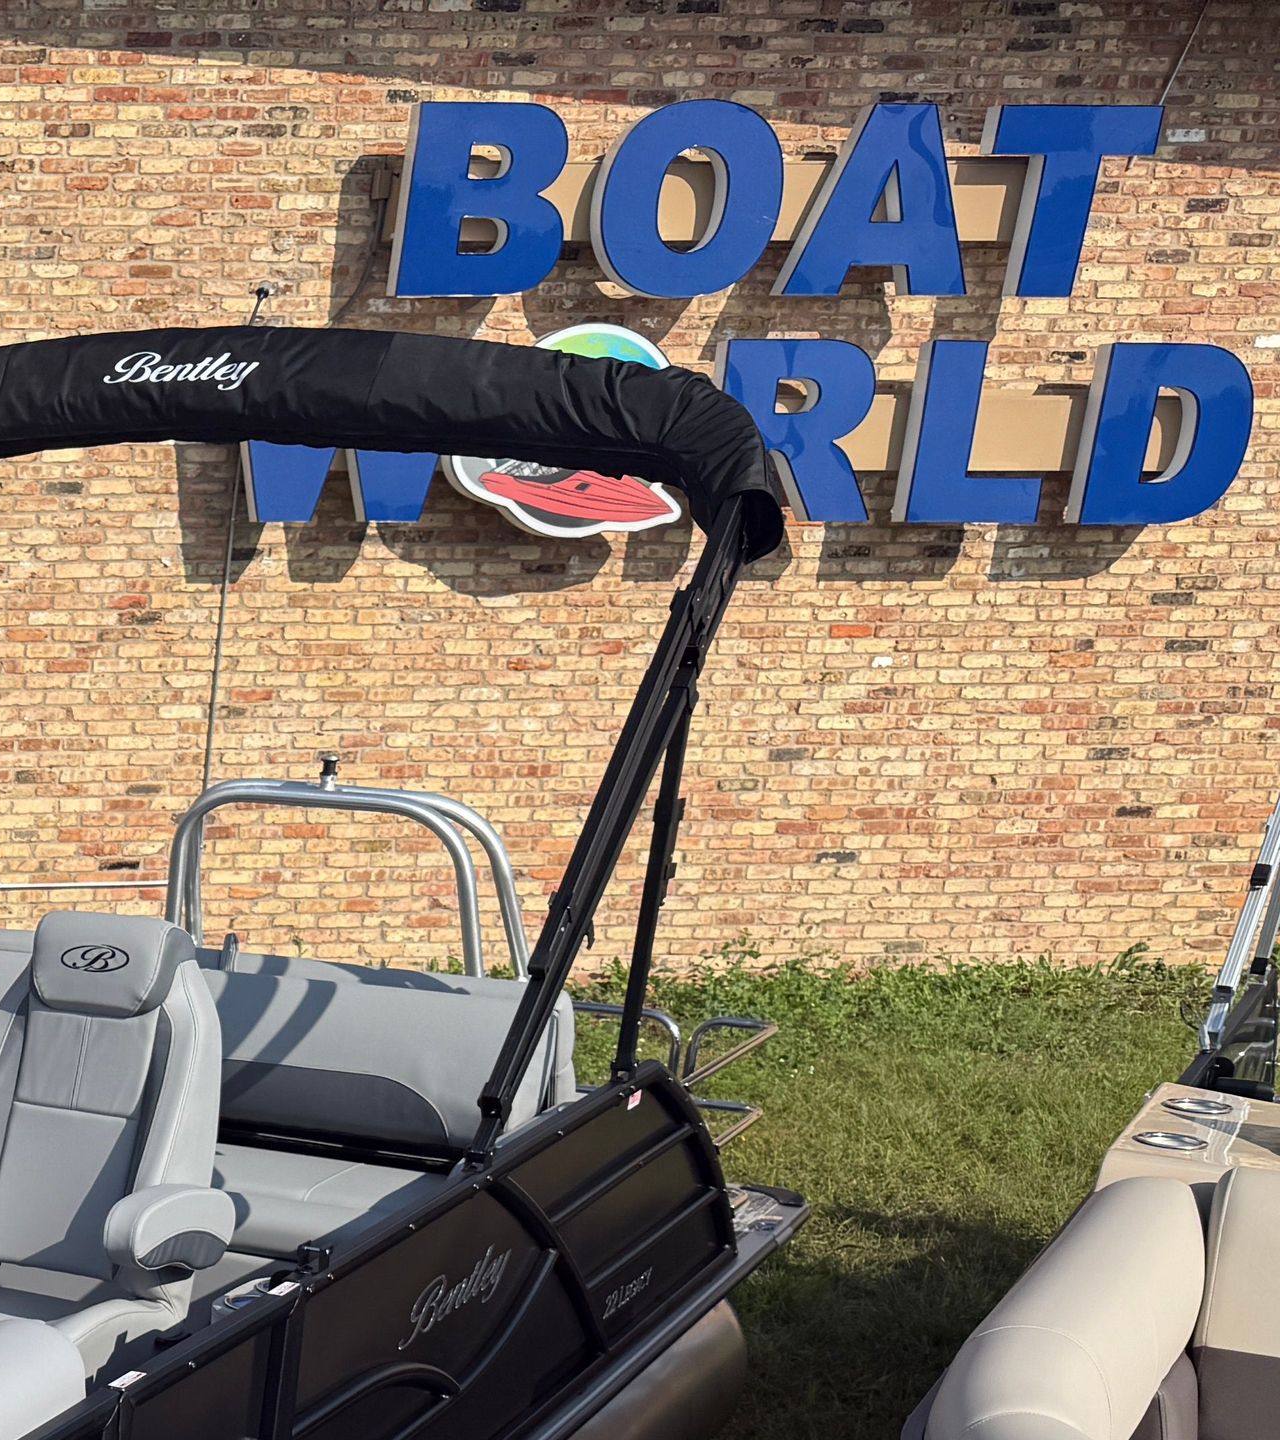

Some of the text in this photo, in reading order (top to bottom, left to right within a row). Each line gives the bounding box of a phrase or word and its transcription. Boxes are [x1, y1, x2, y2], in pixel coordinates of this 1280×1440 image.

[388, 98, 1163, 298] BOAT
[102, 351, 260, 391] Bentley
[244, 338, 1254, 524] RLD
[397, 1243, 512, 1350] Bentley
